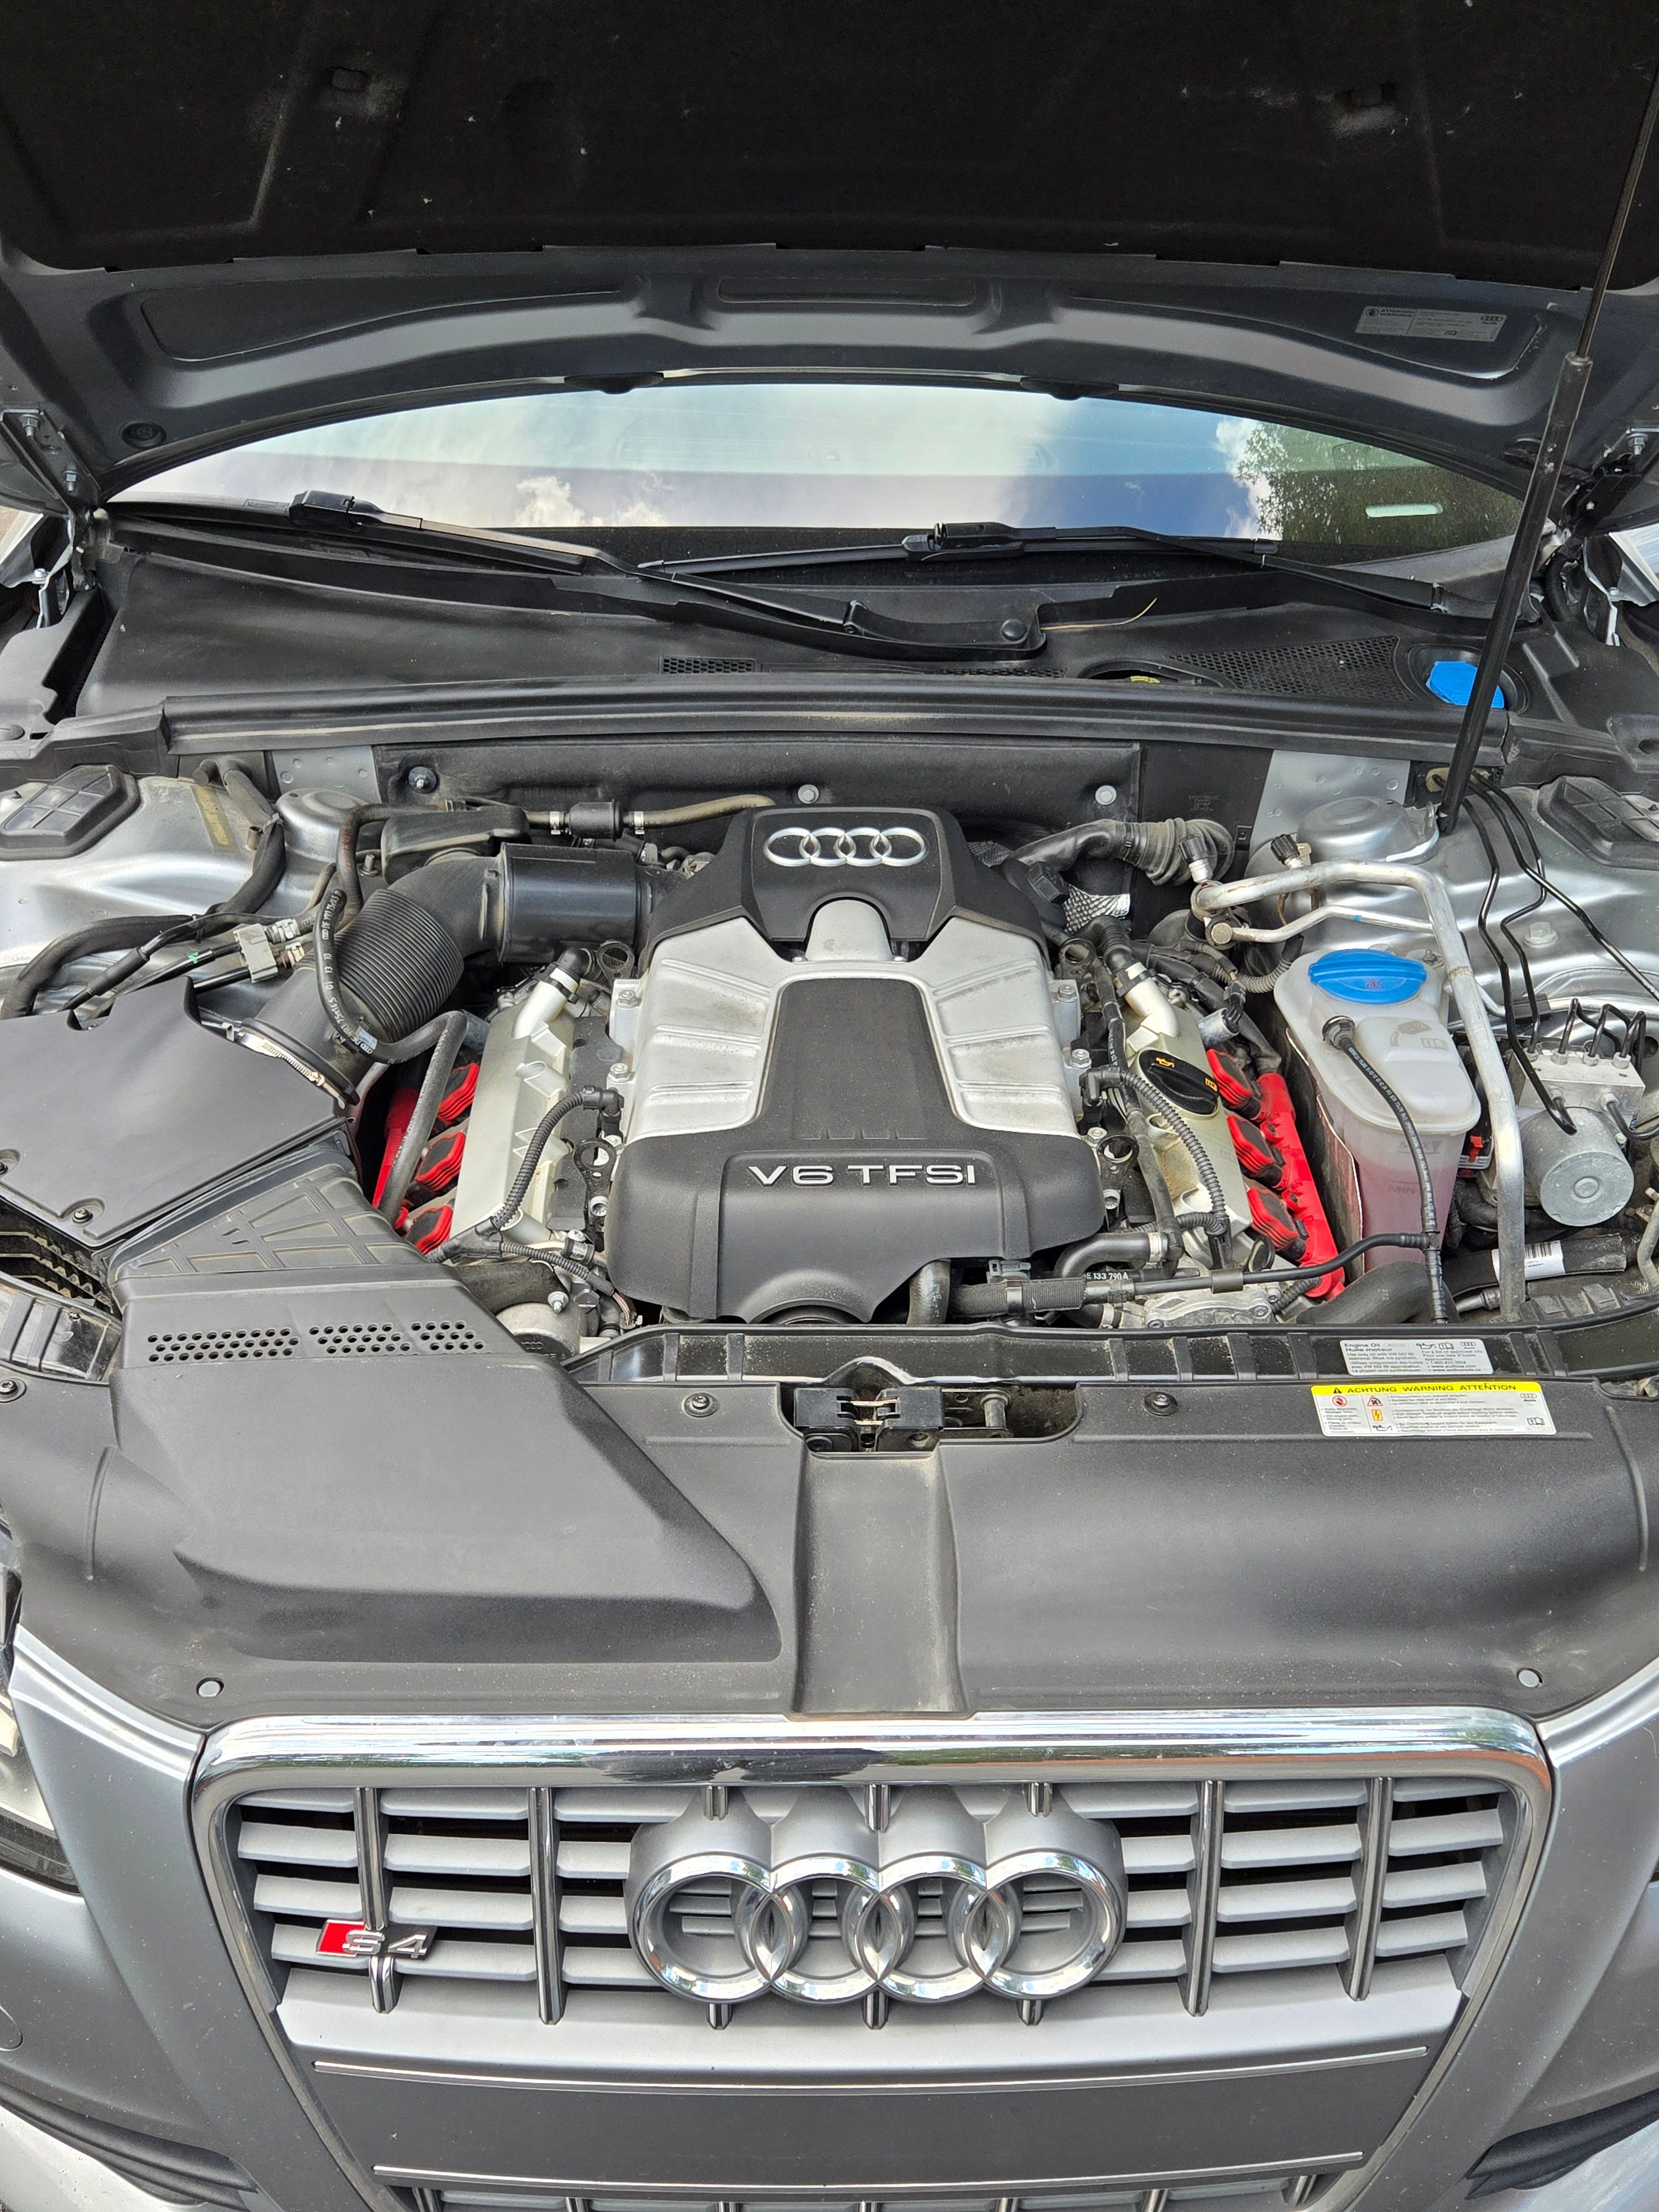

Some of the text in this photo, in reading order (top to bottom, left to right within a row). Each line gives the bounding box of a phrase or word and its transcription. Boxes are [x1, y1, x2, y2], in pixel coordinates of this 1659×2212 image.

[748, 1165, 977, 1187] V6 TFSI
[1389, 1185, 1416, 1194] MIN
[1123, 1271, 1129, 1280] A
[342, 1929, 428, 1959] S4
